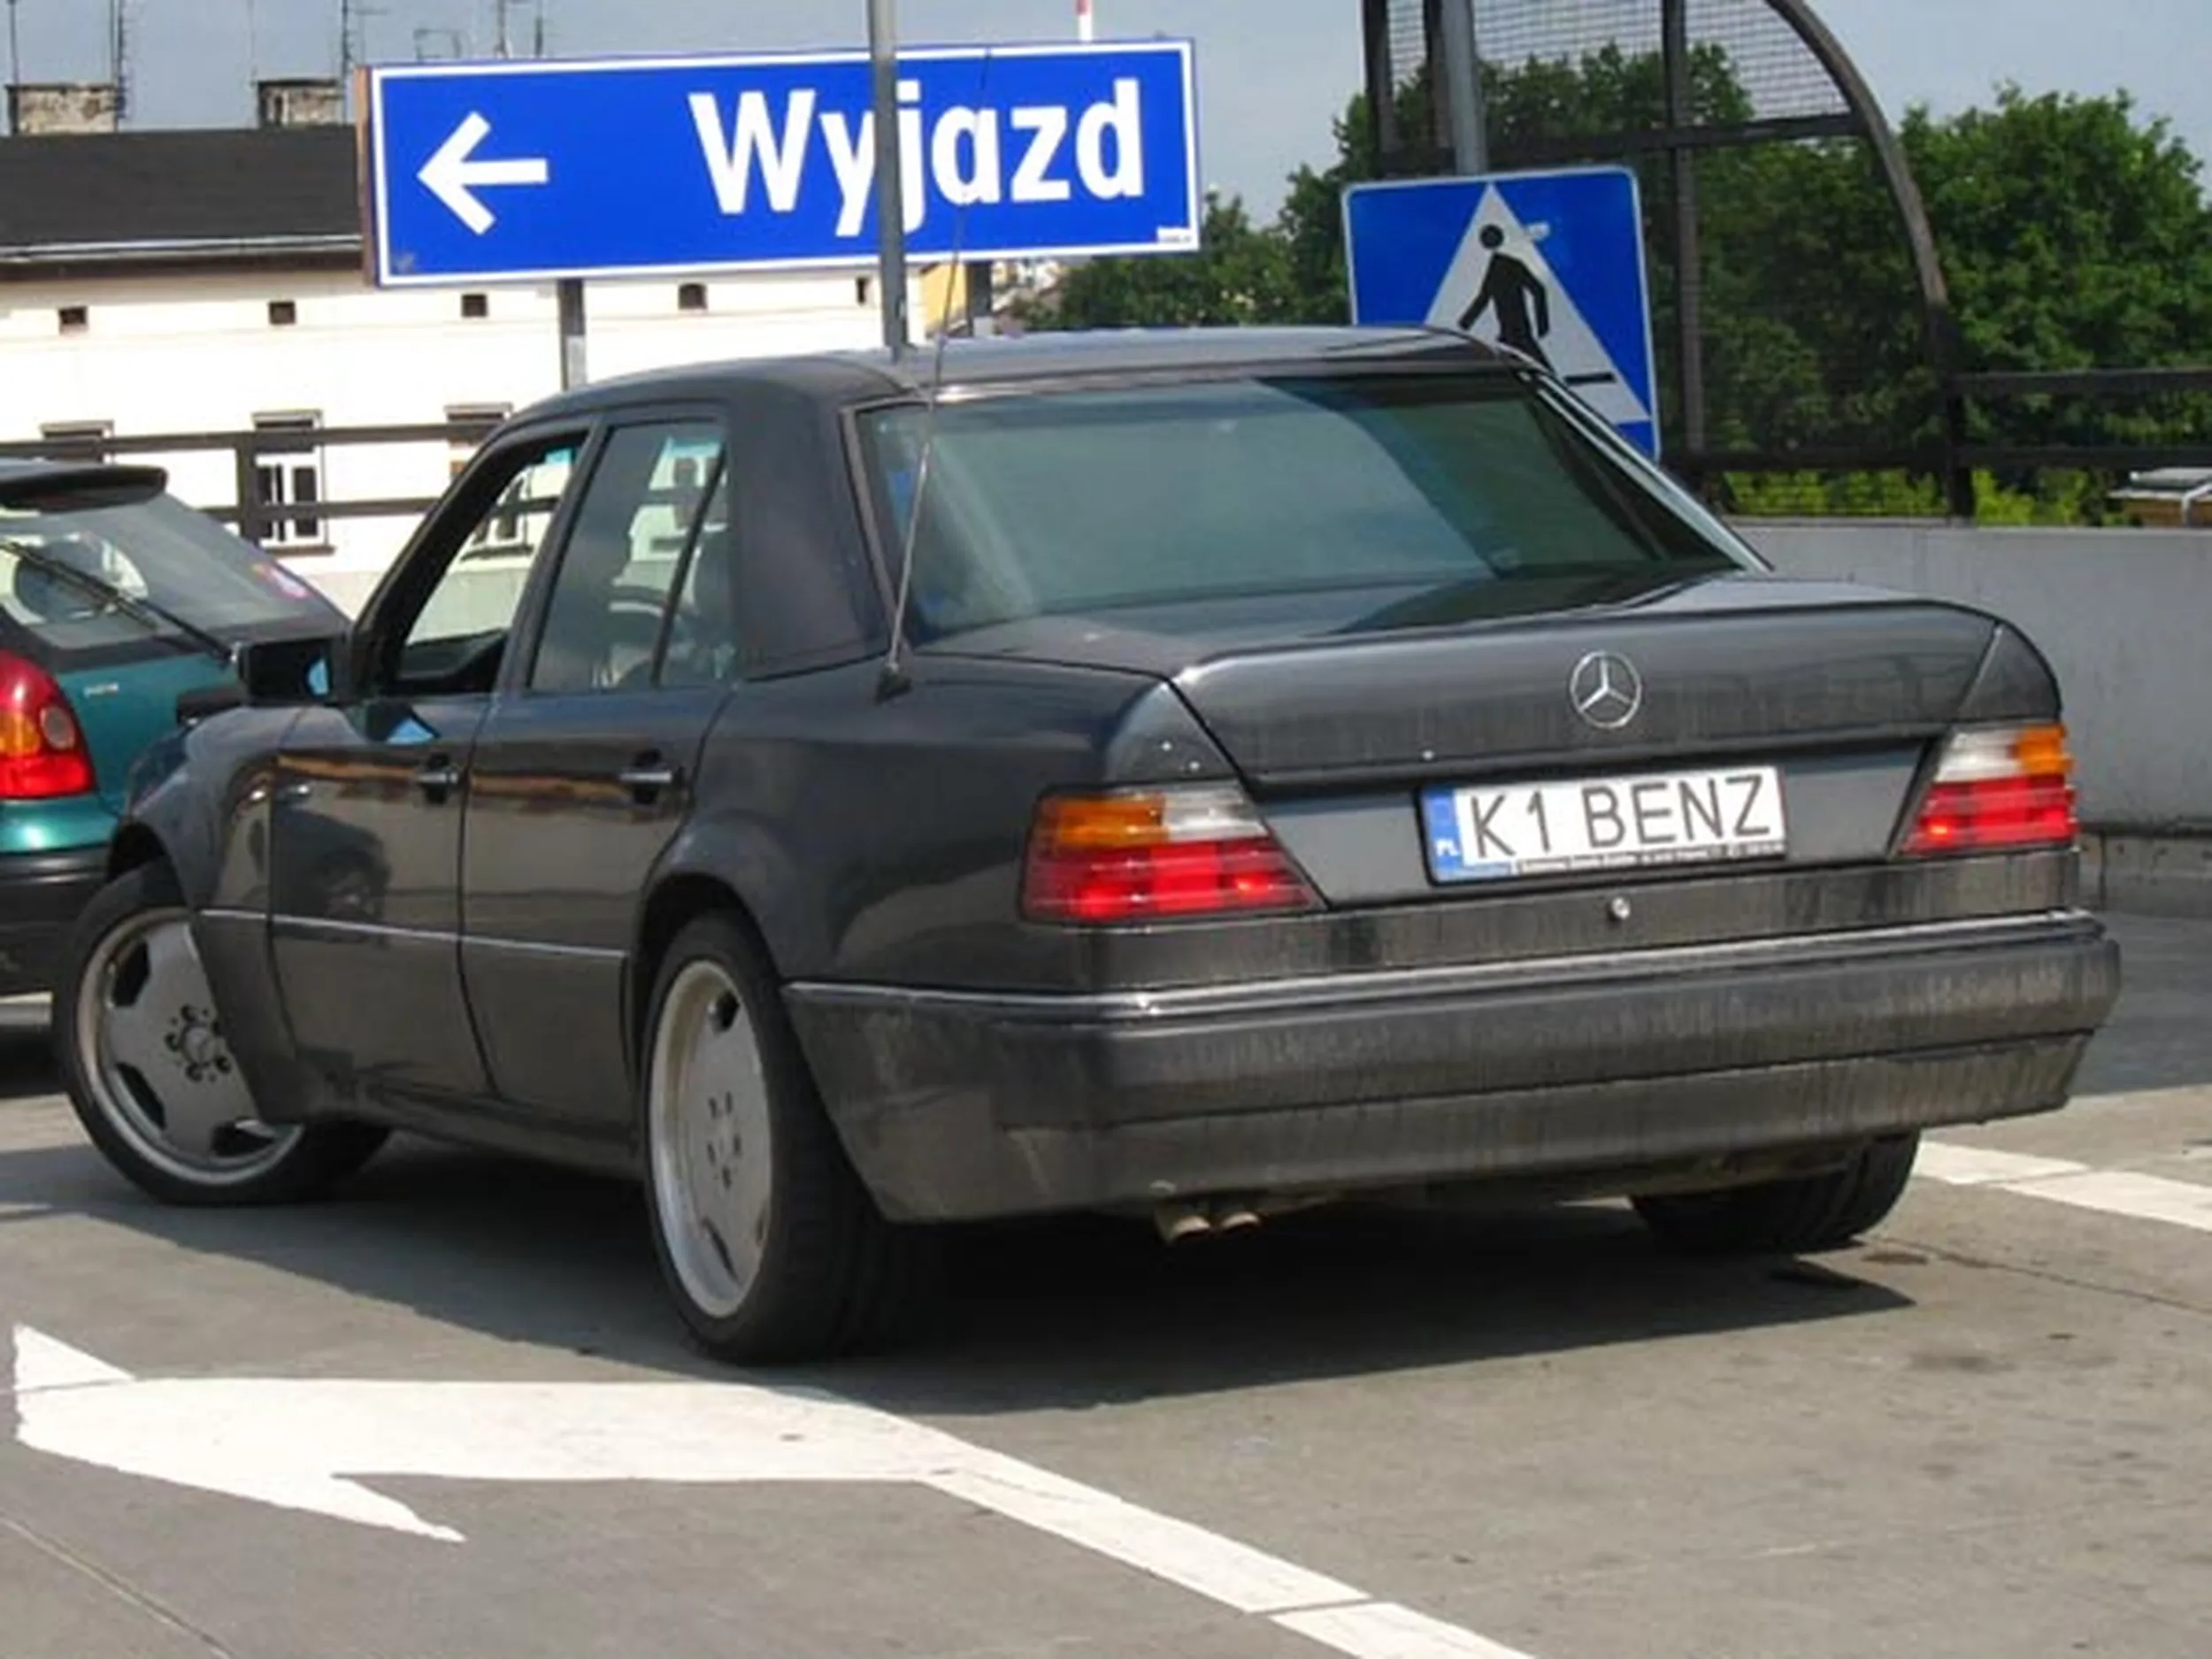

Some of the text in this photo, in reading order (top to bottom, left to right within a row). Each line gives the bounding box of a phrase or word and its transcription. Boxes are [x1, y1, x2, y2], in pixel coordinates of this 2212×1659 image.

[687, 78, 1144, 237] Wyjazd
[1470, 790, 1551, 858] K1
[1580, 773, 1770, 849] BENZ
